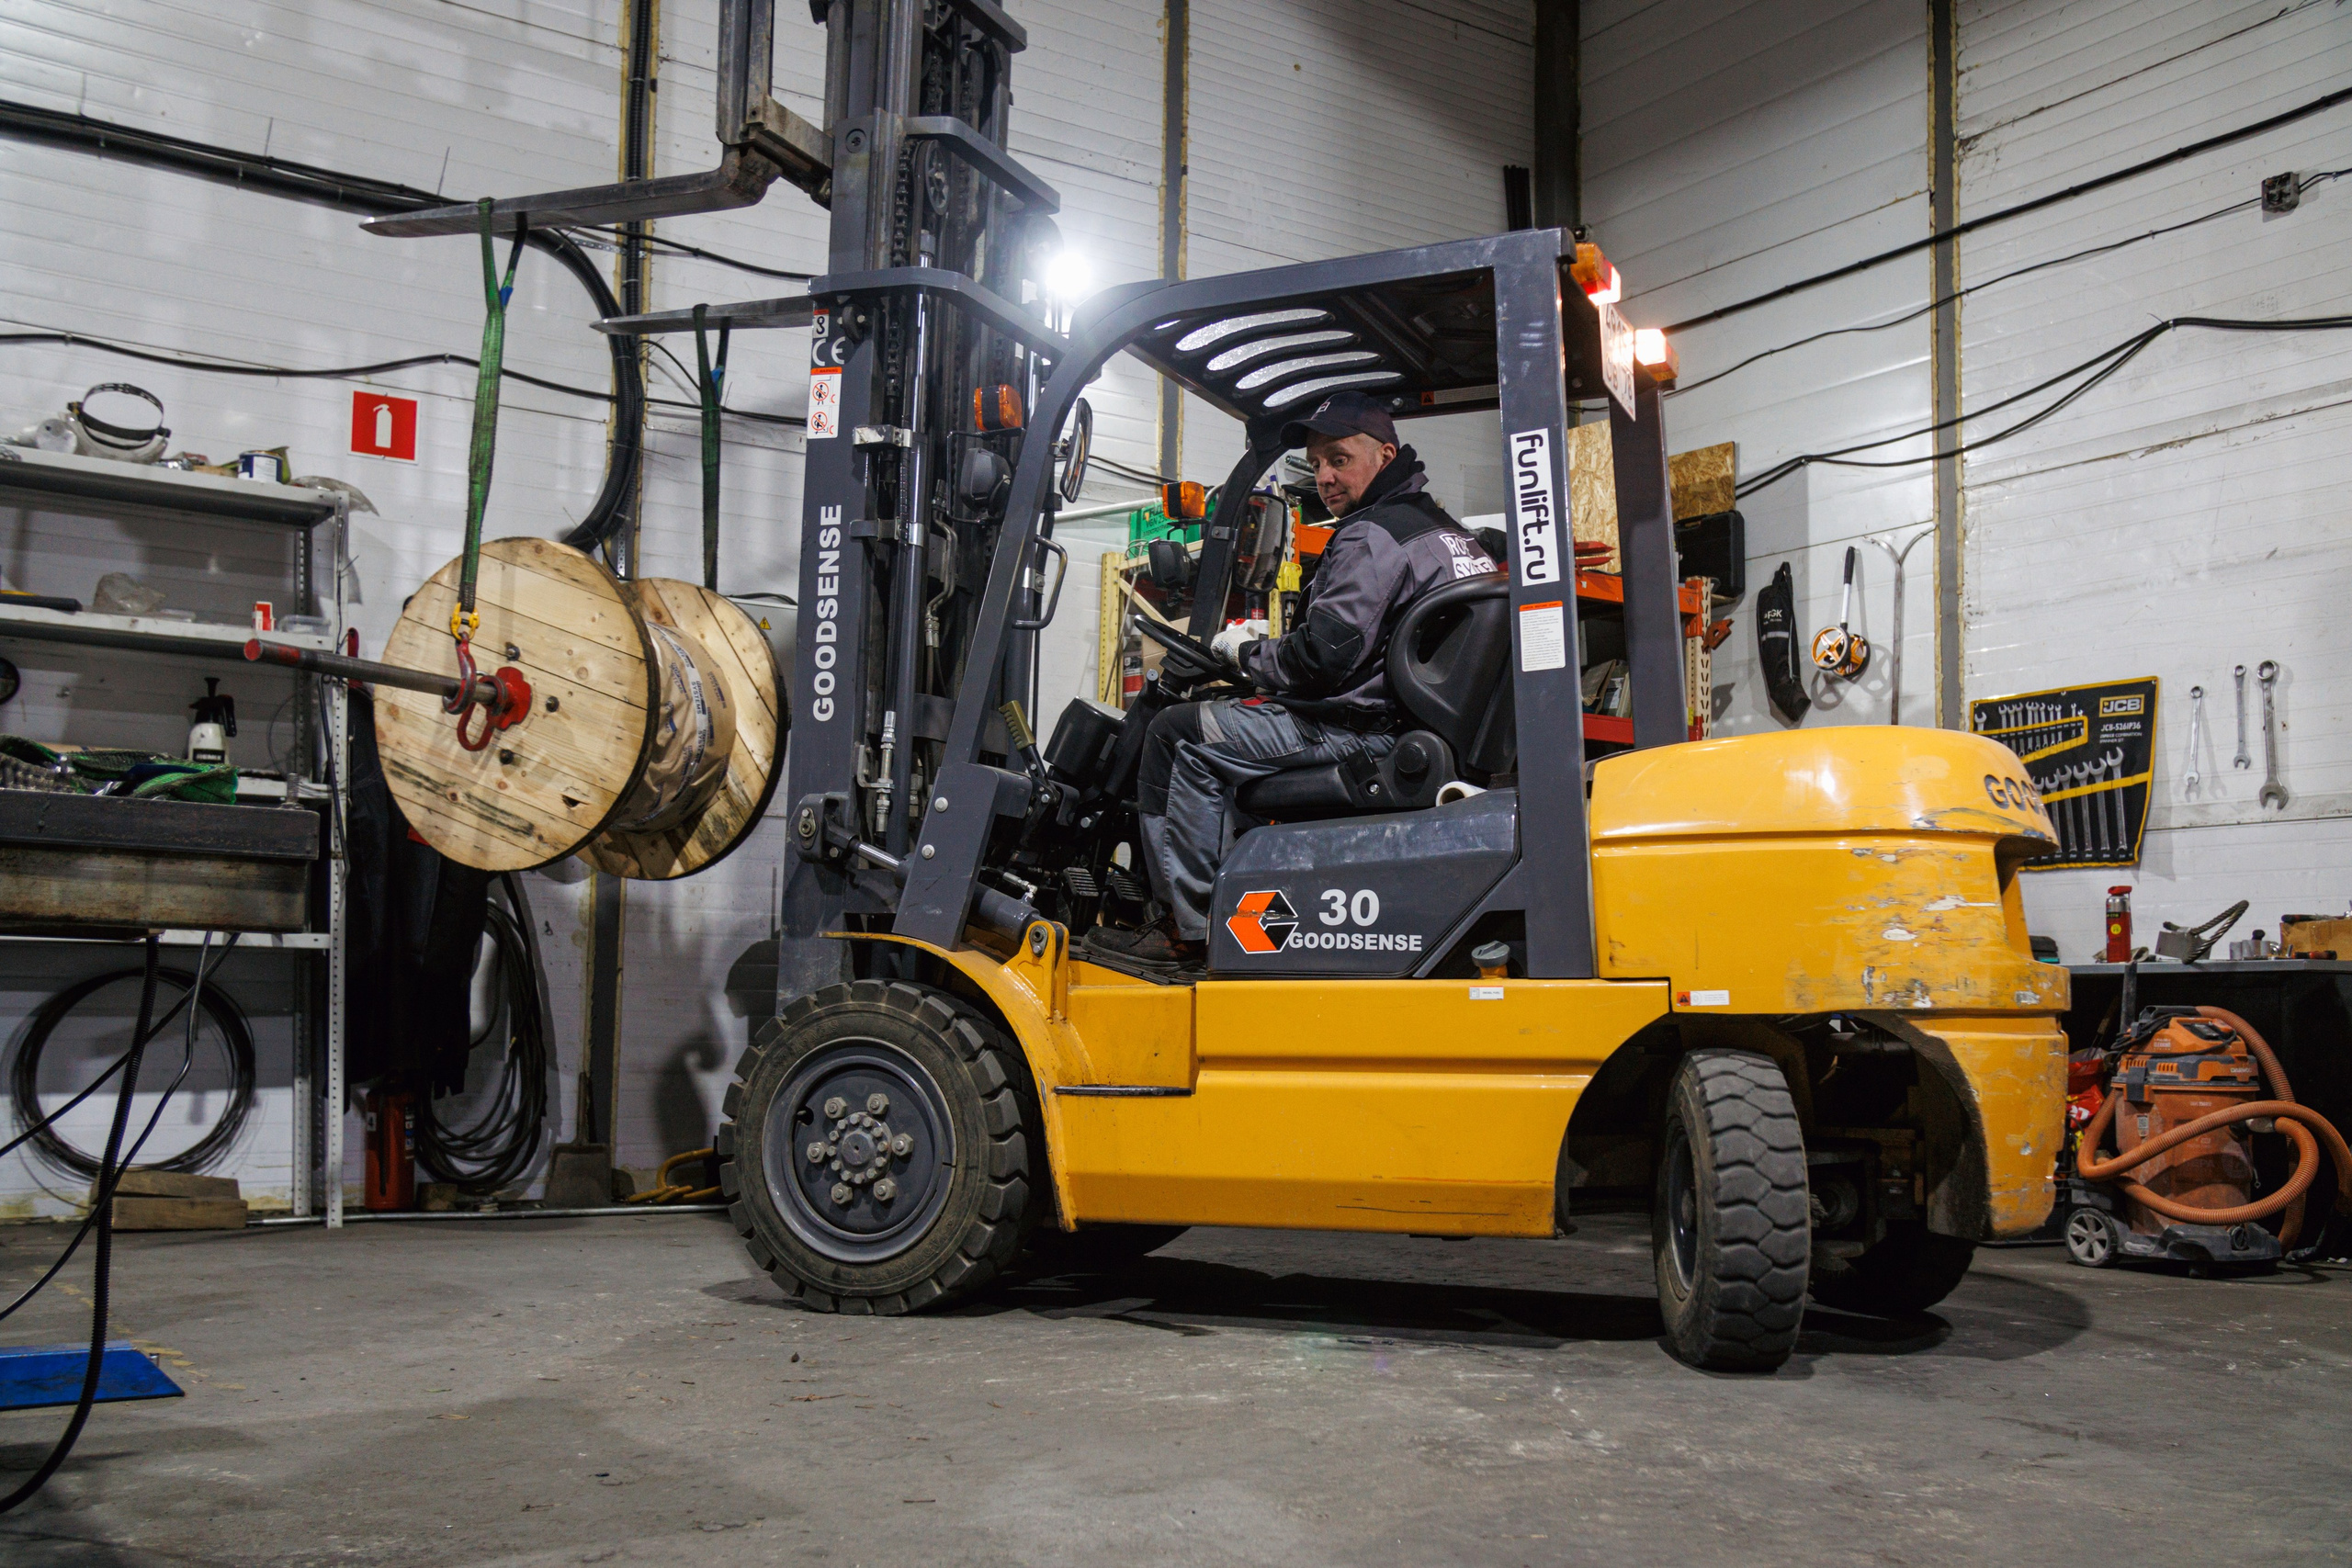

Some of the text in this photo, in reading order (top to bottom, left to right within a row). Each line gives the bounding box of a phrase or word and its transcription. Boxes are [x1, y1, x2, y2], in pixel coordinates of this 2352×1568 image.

[812, 336, 845, 367] CE
[1516, 434, 1549, 580] funlift.ru
[813, 504, 842, 721] GOODSENSE
[691, 681, 702, 715] SYSTEMS
[2103, 698, 2141, 713] JCB
[1318, 888, 1380, 926] 30
[1289, 931, 1422, 952] GOODSENSE
